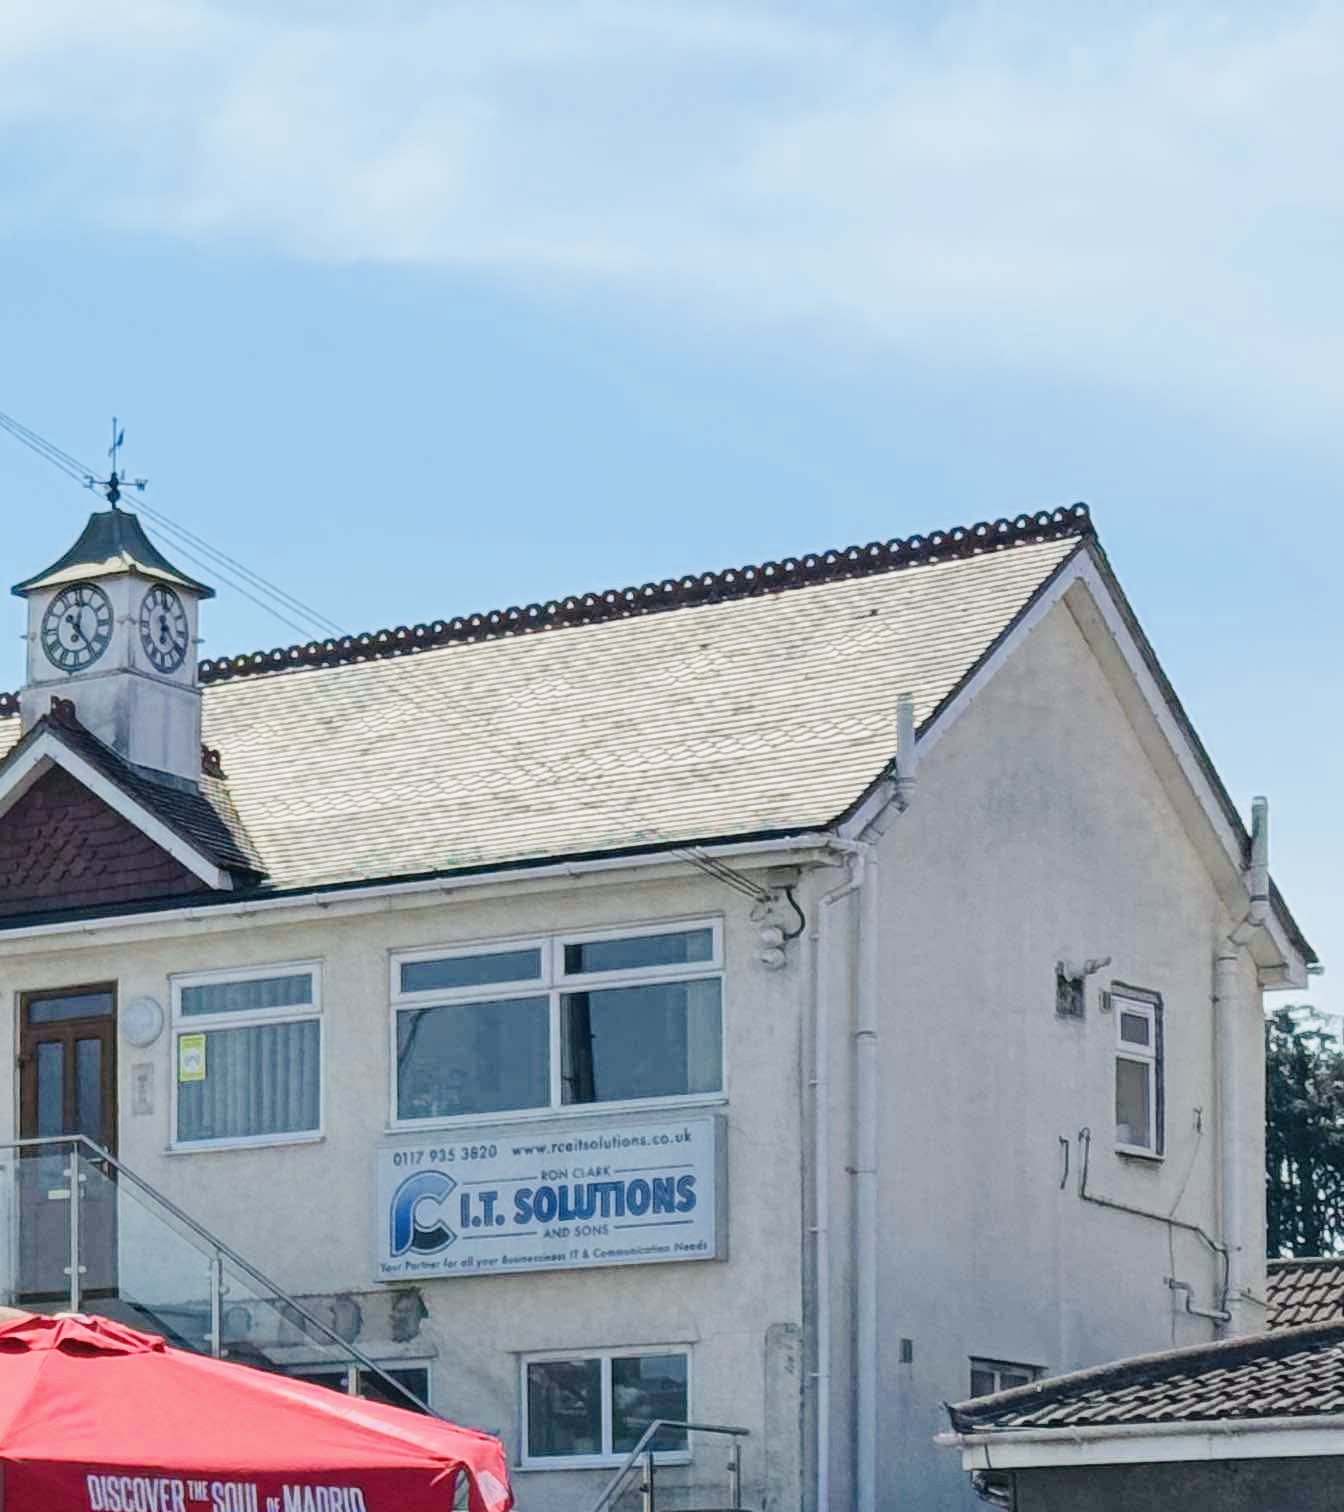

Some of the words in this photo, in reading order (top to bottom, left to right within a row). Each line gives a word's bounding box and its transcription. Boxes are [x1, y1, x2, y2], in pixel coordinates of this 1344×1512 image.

[393, 1151, 425, 1167] 0117
[429, 1149, 455, 1163] 935
[461, 1144, 498, 1161] 3820
[512, 1127, 692, 1156] www.rceitsolutions.co.uk
[541, 1167, 568, 1181] RON
[572, 1165, 611, 1179] CLARK
[460, 1190, 506, 1229] I.T.
[513, 1174, 697, 1225] SOLUTIONS
[543, 1226, 570, 1239] AND
[574, 1224, 610, 1237] SONS
[186, 1479, 210, 1502] THE
